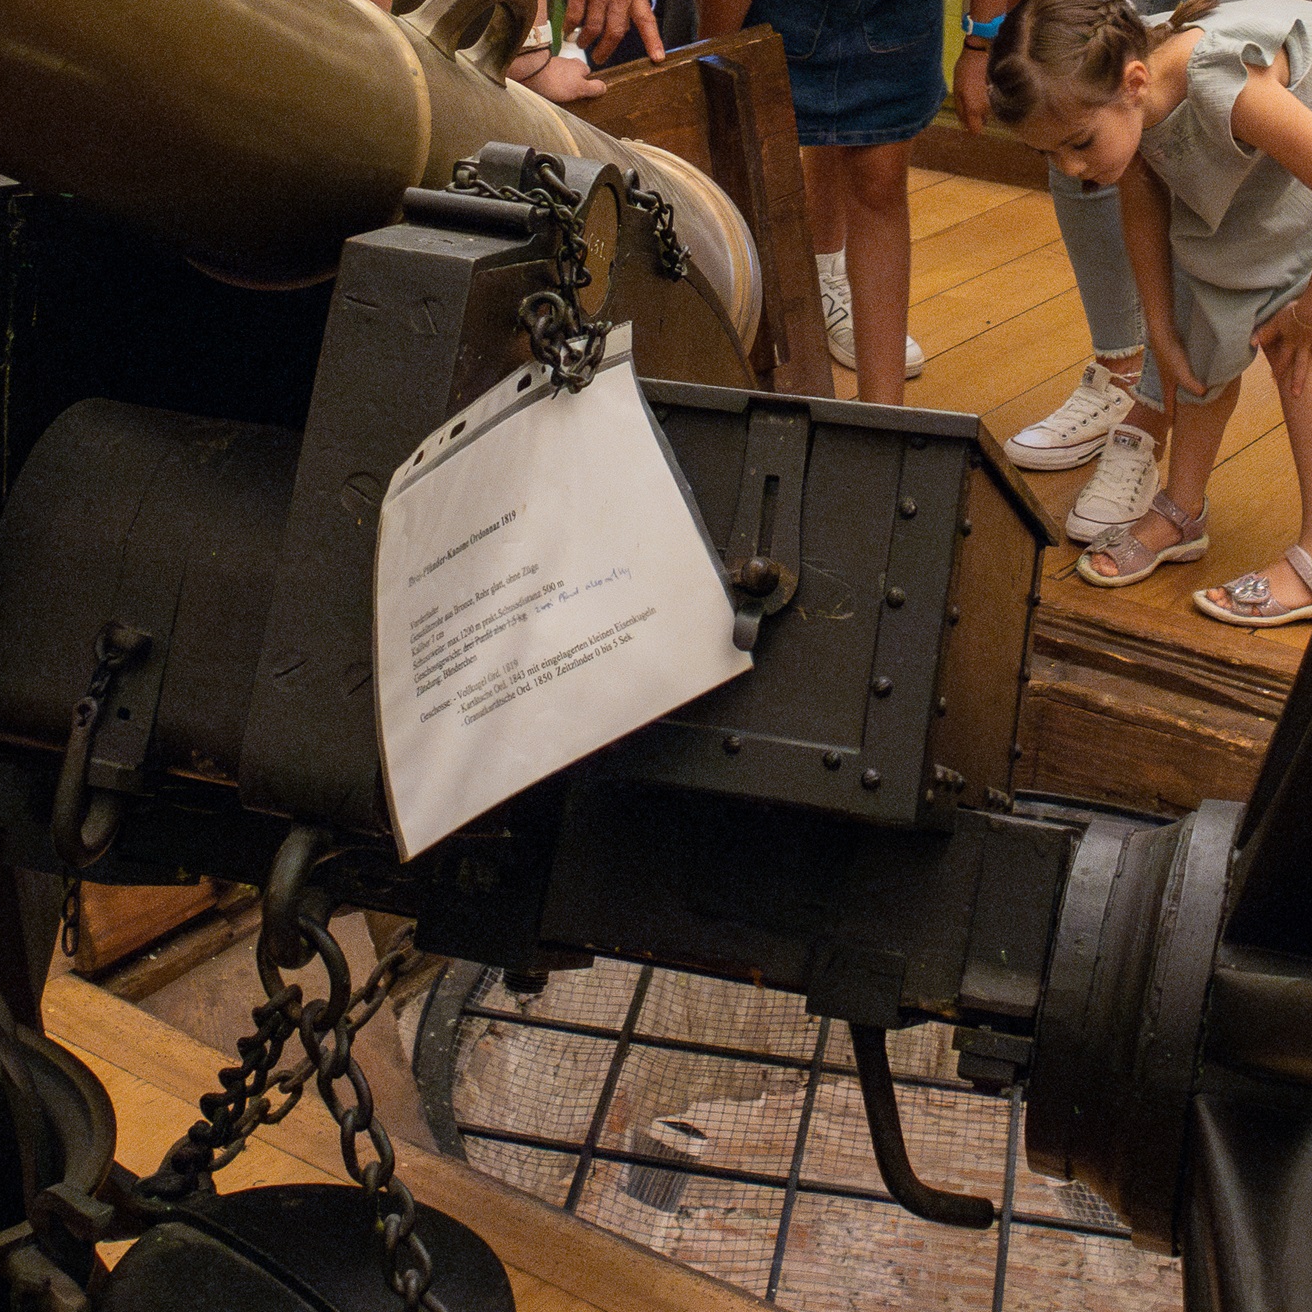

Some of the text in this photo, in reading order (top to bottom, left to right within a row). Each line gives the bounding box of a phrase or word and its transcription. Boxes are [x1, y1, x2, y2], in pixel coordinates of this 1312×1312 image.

[500, 510, 516, 526] 1819
[475, 589, 489, 601] Rohr
[506, 572, 521, 585] ohne
[542, 581, 556, 595] 500
[557, 579, 564, 588] m
[411, 637, 430, 657] Kaliber
[509, 670, 526, 685] 1843
[527, 664, 540, 676] mit
[541, 641, 588, 669] eingelagerten
[588, 628, 615, 645] kleinen
[614, 606, 656, 632] Eisenkugeln
[516, 681, 533, 696] Ord.
[533, 671, 553, 687] 1850
[556, 653, 594, 677] Zeitzünder
[594, 647, 601, 657] 0
[601, 643, 612, 654] bis
[612, 638, 618, 648] 5
[457, 676, 487, 699] Vollkugel
